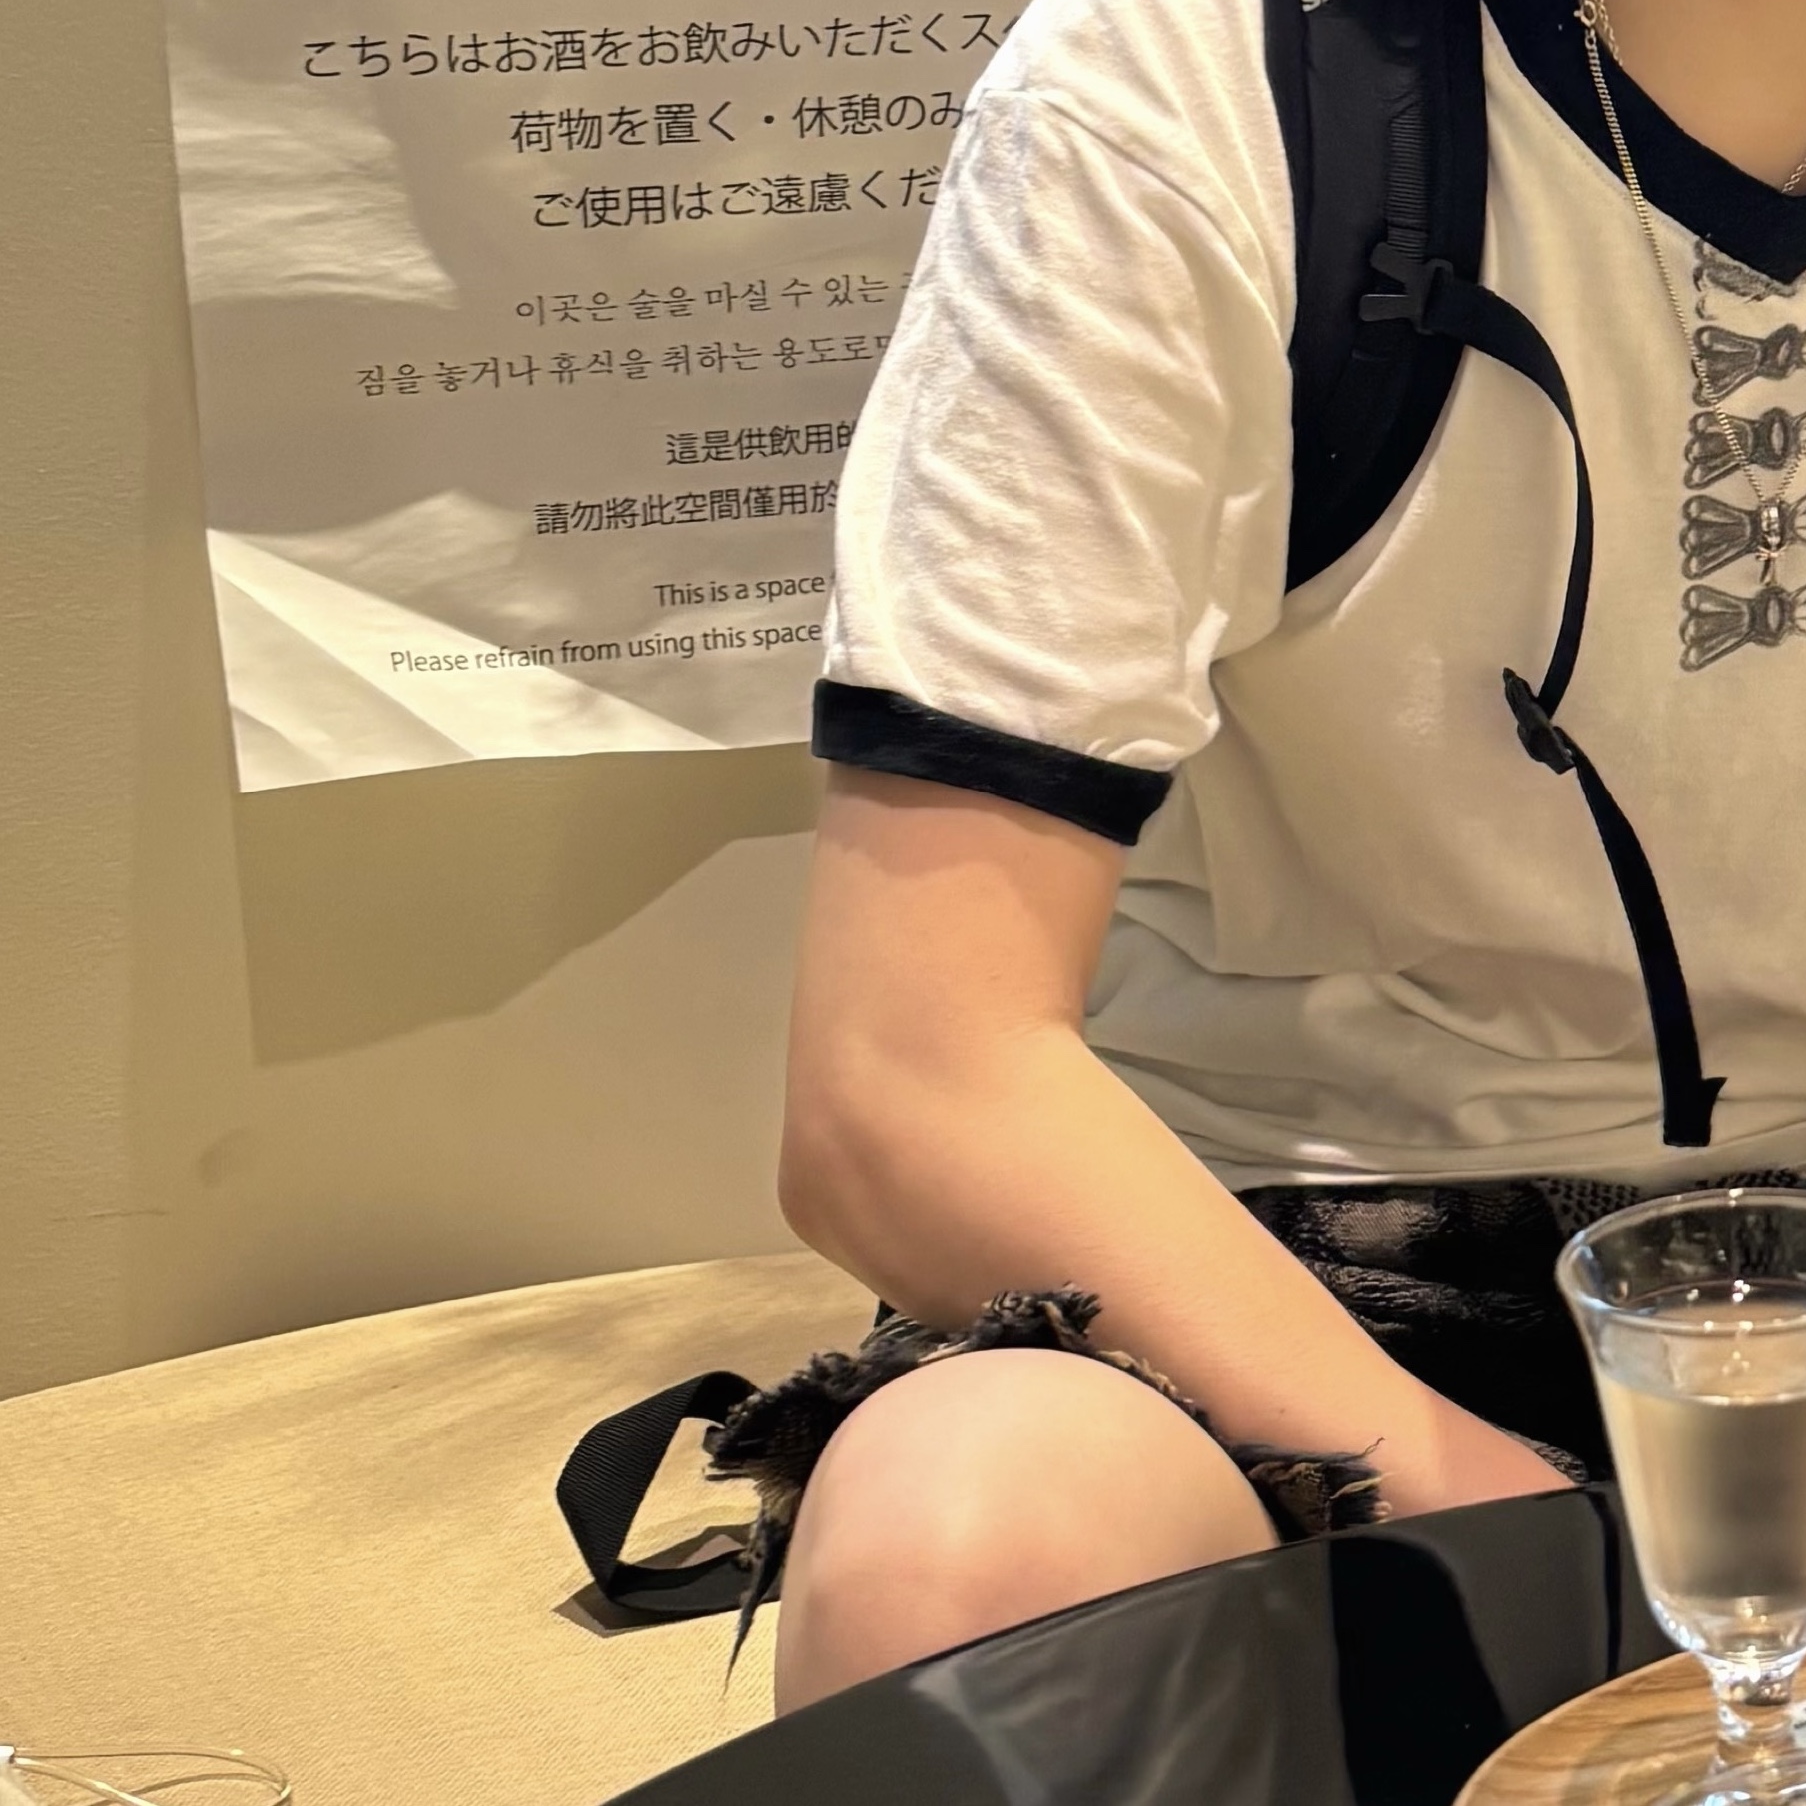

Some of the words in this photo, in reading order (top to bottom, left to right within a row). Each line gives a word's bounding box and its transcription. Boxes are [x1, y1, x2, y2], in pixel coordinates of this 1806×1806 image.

[510, 91, 968, 153] 荷物を置く・休憩のみ
[534, 165, 942, 229] ご使用はご遠慮くだ
[516, 292, 618, 326] 이곳은
[628, 287, 696, 320] 술을
[704, 279, 771, 313] 마실
[781, 277, 813, 308] 수
[824, 274, 889, 308] 있는
[357, 363, 425, 397] 짐을
[433, 354, 541, 392] 놓거나
[548, 348, 652, 385] 휴식을
[661, 342, 762, 376] 취하는
[666, 420, 856, 466] 這是供飲用的
[533, 479, 838, 535] 請勿將此空間僅用於
[653, 582, 704, 607] This
[710, 581, 729, 603] is
[735, 583, 749, 600] a
[755, 576, 826, 603] space
[390, 650, 469, 672] Please
[474, 645, 554, 669] refrain
[560, 640, 622, 664] from
[628, 632, 695, 658] using
[702, 627, 746, 650] this
[752, 624, 822, 650] space
